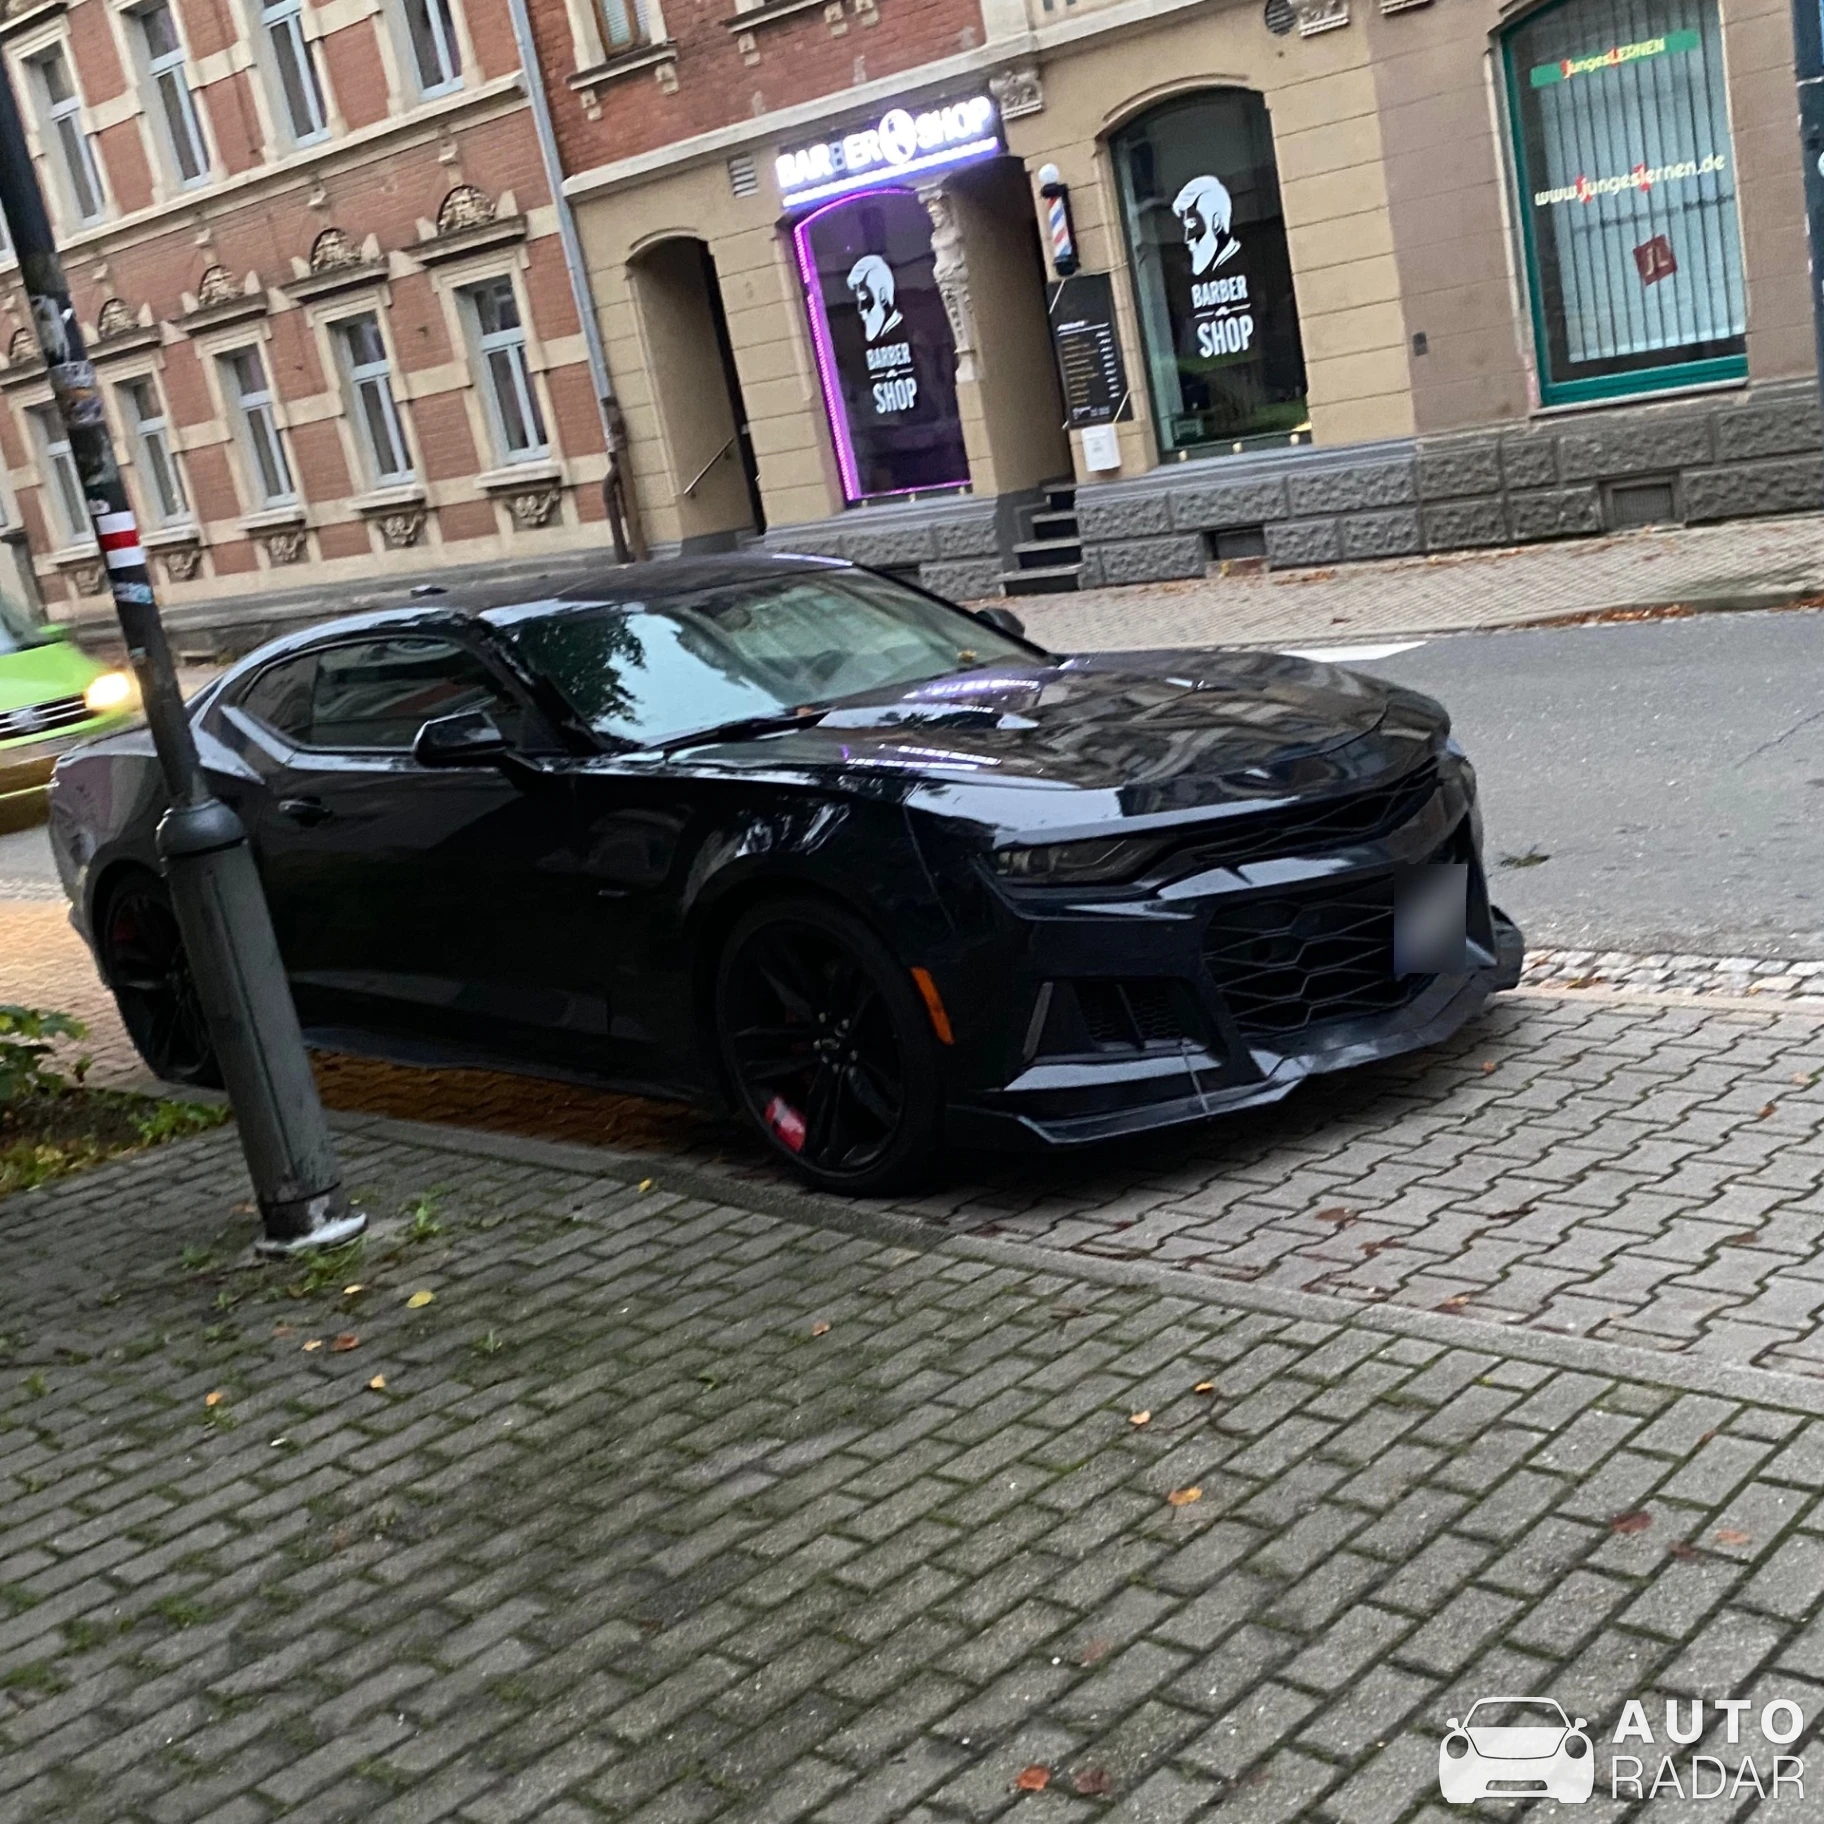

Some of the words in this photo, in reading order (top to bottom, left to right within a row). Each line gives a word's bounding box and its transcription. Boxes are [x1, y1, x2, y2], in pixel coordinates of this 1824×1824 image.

[775, 129, 881, 188] BARBER
[915, 96, 991, 149] SHOP
[1191, 274, 1248, 309] BARBER
[1197, 314, 1254, 358] SHOP
[865, 342, 912, 371] BARBER
[872, 377, 918, 414] SHOP
